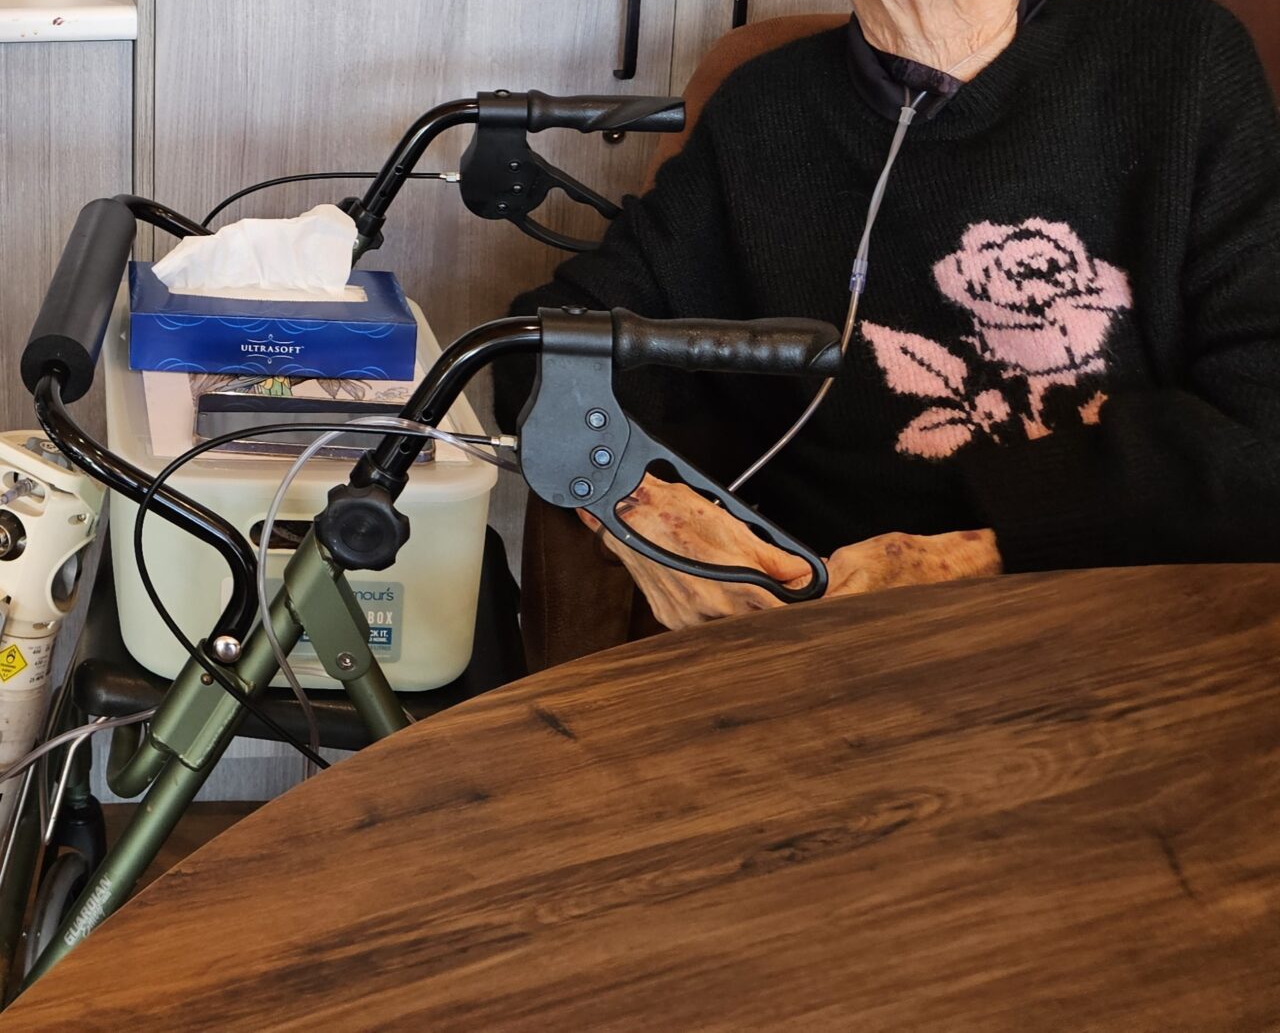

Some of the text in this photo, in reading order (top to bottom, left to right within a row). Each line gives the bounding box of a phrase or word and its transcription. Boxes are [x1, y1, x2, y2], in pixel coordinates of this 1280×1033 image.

[241, 344, 302, 354] ULTRASOFT
[367, 610, 393, 625] BOX
[63, 873, 113, 946] GUARDIAN
